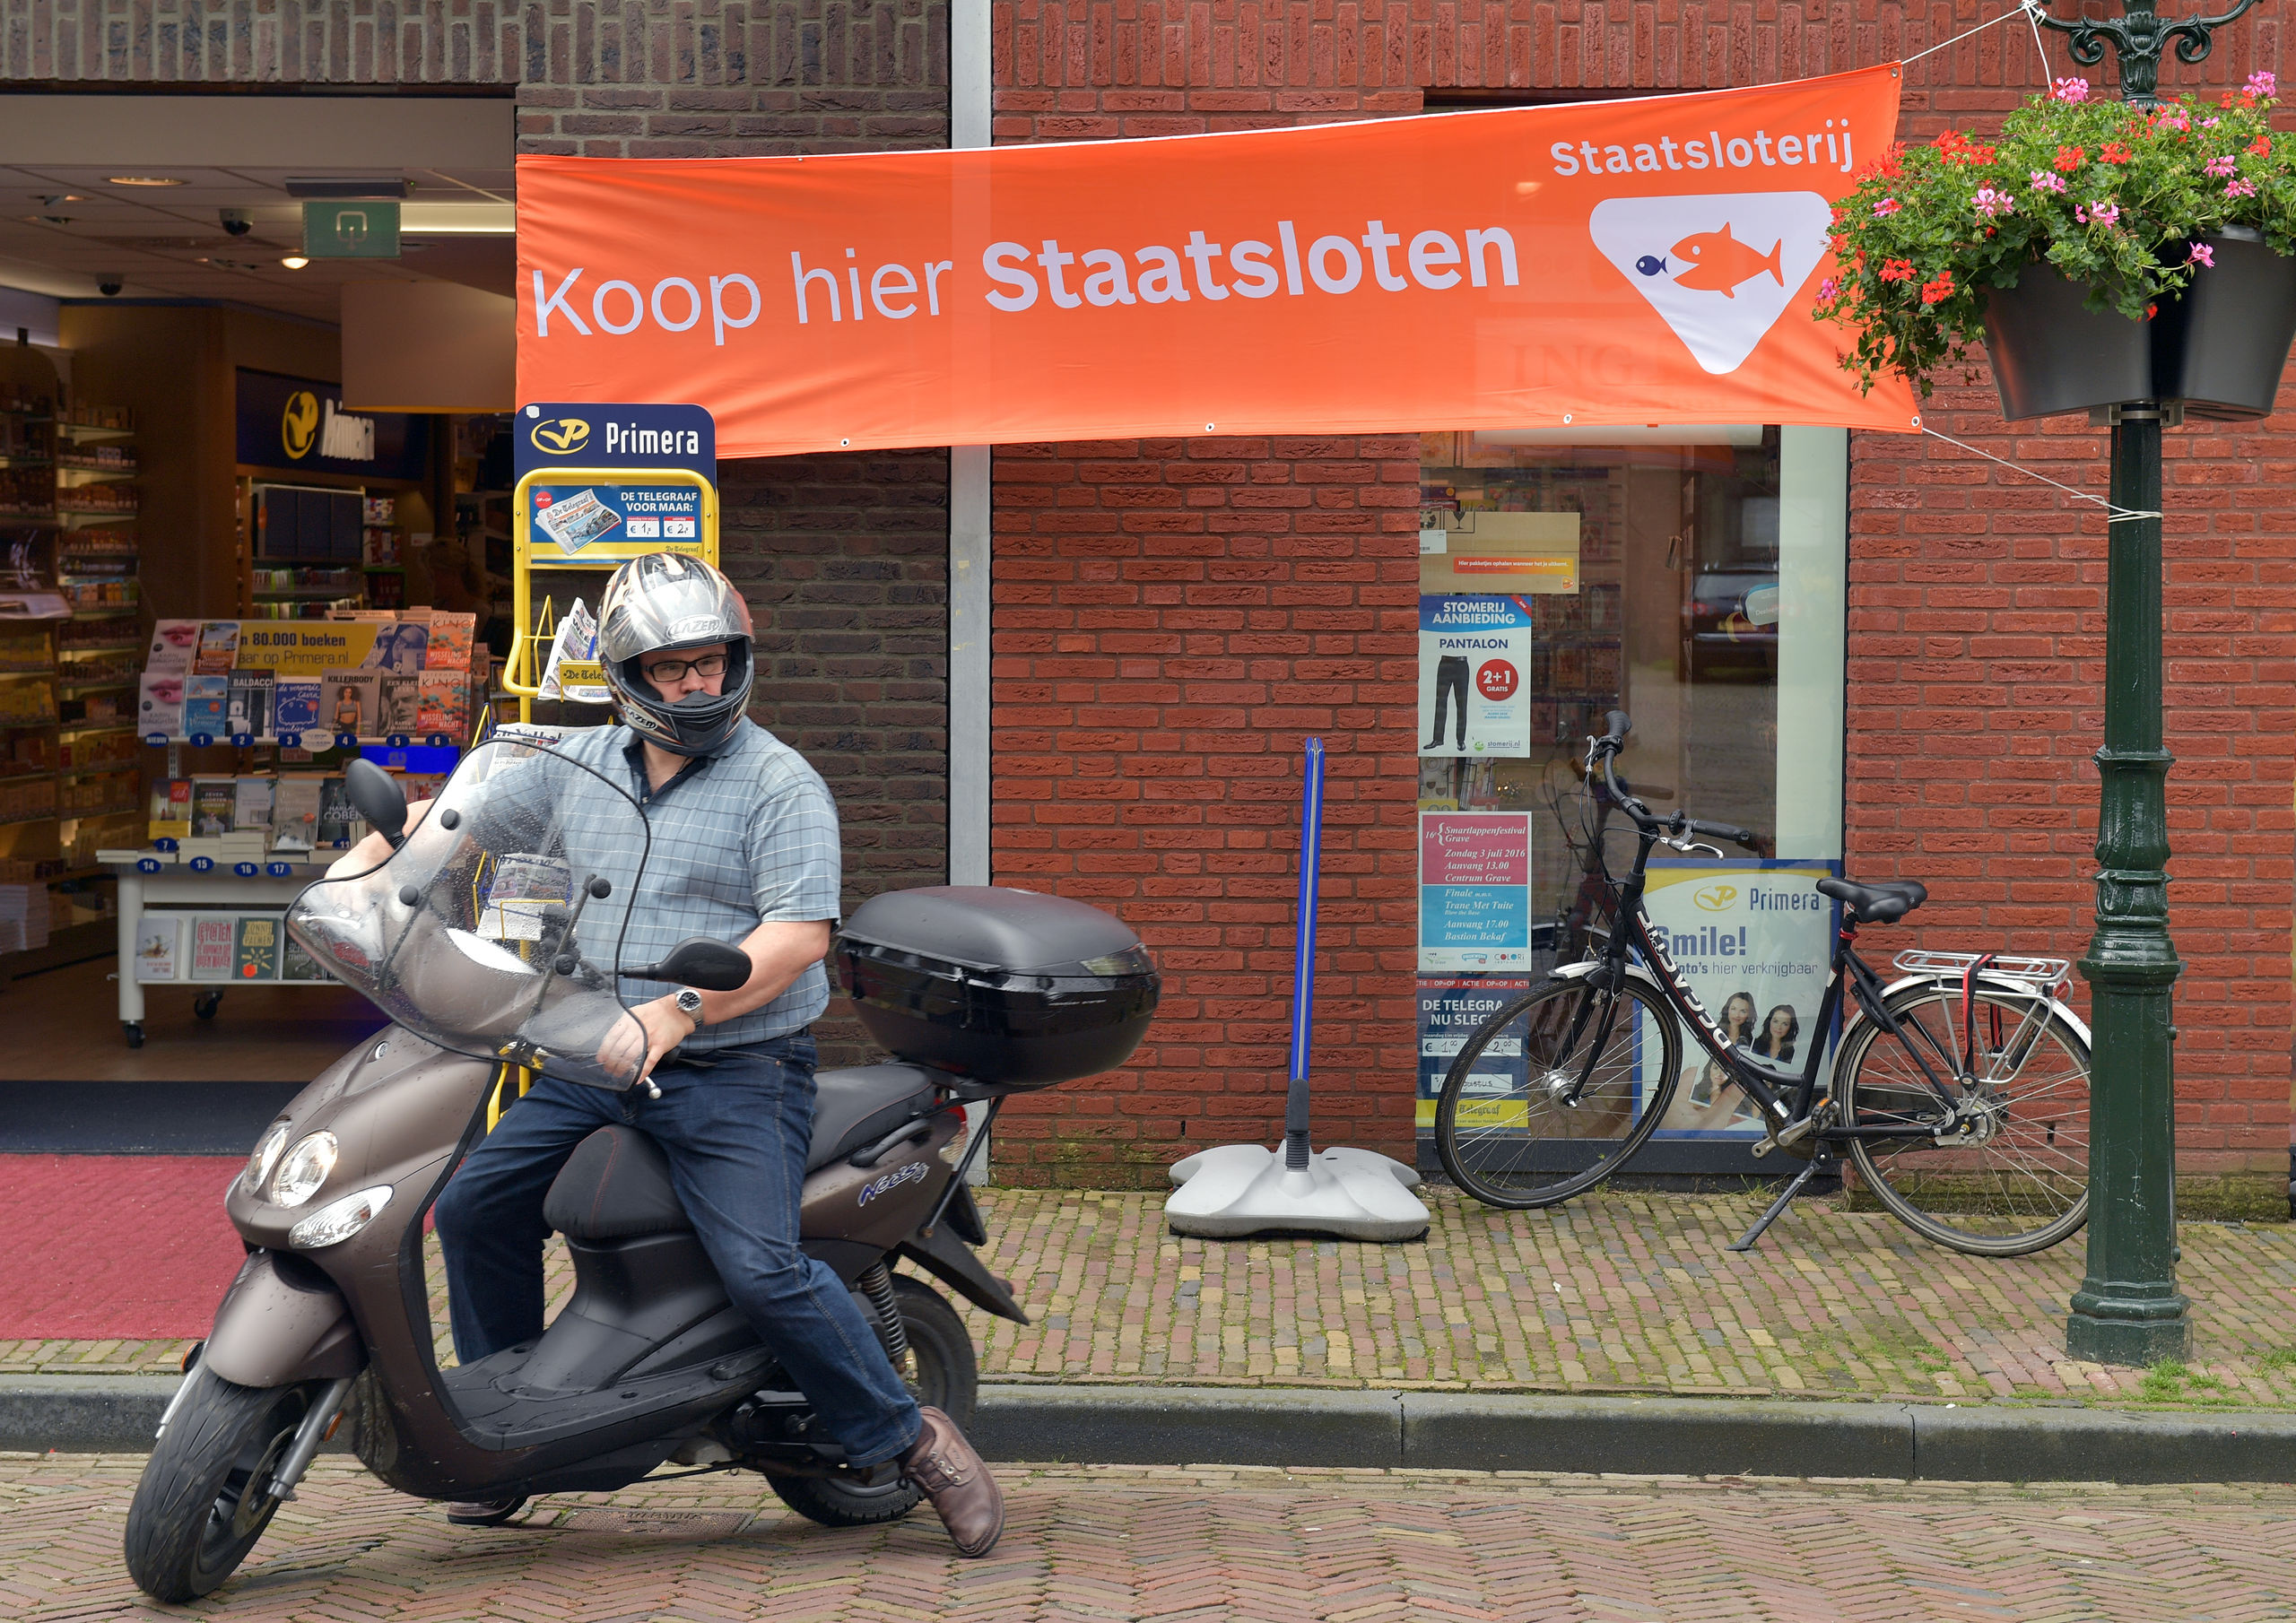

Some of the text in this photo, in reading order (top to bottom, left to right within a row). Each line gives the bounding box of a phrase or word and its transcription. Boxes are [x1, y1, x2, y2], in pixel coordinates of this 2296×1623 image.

[1550, 118, 1853, 178] Staatsloterij
[531, 220, 1520, 347] Koop hier Staatsloten
[605, 422, 700, 456] Primera
[621, 492, 698, 501] DE TELEGRAAF
[626, 502, 693, 512] VOOR MAAR:
[1443, 602, 1506, 614] STOMERIJ
[1432, 613, 1516, 624] AANBIEDING
[433, 620, 472, 629] KING
[673, 619, 718, 633] LAZER
[252, 632, 297, 646] 80.000
[301, 632, 346, 647] boeken
[1439, 638, 1509, 648] PANTALON
[264, 654, 279, 665] op
[283, 650, 349, 664] Primera.nl
[327, 675, 374, 683] KILLERBODY
[566, 670, 579, 680] De
[1483, 670, 1510, 684] 2+1
[233, 679, 274, 687] BALDACCI
[422, 679, 461, 688] KING
[198, 735, 204, 745] 1
[239, 735, 245, 745] 2
[286, 735, 292, 745] 3
[343, 736, 348, 745] 4
[395, 737, 401, 746] 5
[435, 737, 440, 746] 6
[1487, 740, 1521, 749] stomerij.nl
[1444, 826, 1526, 836] Smartlappenfestival
[162, 839, 168, 849] 7
[1445, 835, 1470, 843] Grave
[1444, 848, 1526, 859] Zondag 3 juli 2016
[143, 861, 154, 871] 14
[196, 859, 207, 869] 15
[240, 864, 252, 874] 16
[274, 864, 285, 874] 17
[1444, 861, 1509, 872] Aanvang 13.00
[1445, 873, 1511, 882] Centrum Grave
[1445, 889, 1473, 898] Finale
[1750, 888, 1820, 911] Primera
[1445, 901, 1514, 910] Trane Met Tuite
[1444, 919, 1509, 930] Aanvang 17.00
[1445, 932, 1507, 942] Bastion Bekaf
[1657, 925, 1746, 956] Smile!
[1713, 961, 1737, 974] hier
[1742, 961, 1818, 977] verkrijgbaar
[1422, 1000, 1503, 1011] DE TELEGRA
[1431, 1014, 1451, 1025] NU
